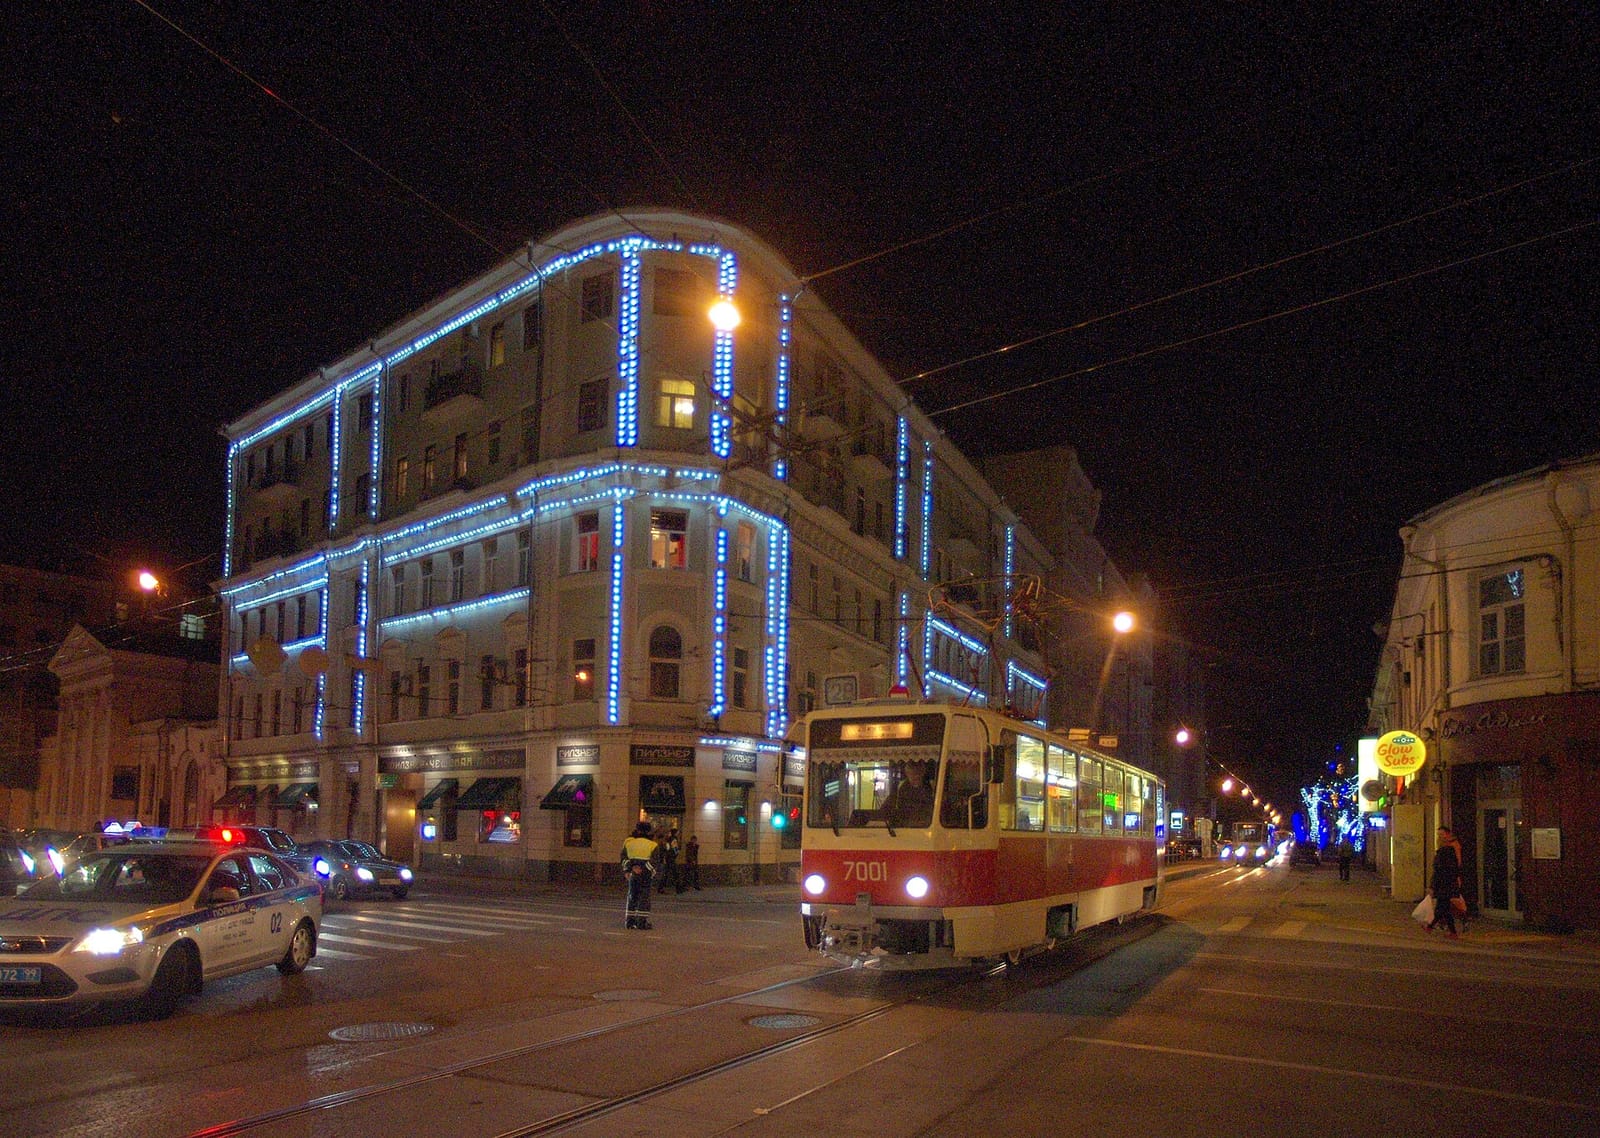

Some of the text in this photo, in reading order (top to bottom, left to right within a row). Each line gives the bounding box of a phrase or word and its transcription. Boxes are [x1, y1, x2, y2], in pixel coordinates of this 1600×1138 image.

[559, 748, 599, 758] ПИЛЗНЕР
[635, 748, 691, 759] ПИЛЗНЕР
[1377, 743, 1413, 756] Glow
[1383, 755, 1416, 767] Subs
[842, 861, 887, 881] 7001
[270, 912, 282, 933] 02
[0, 969, 17, 980] 72
